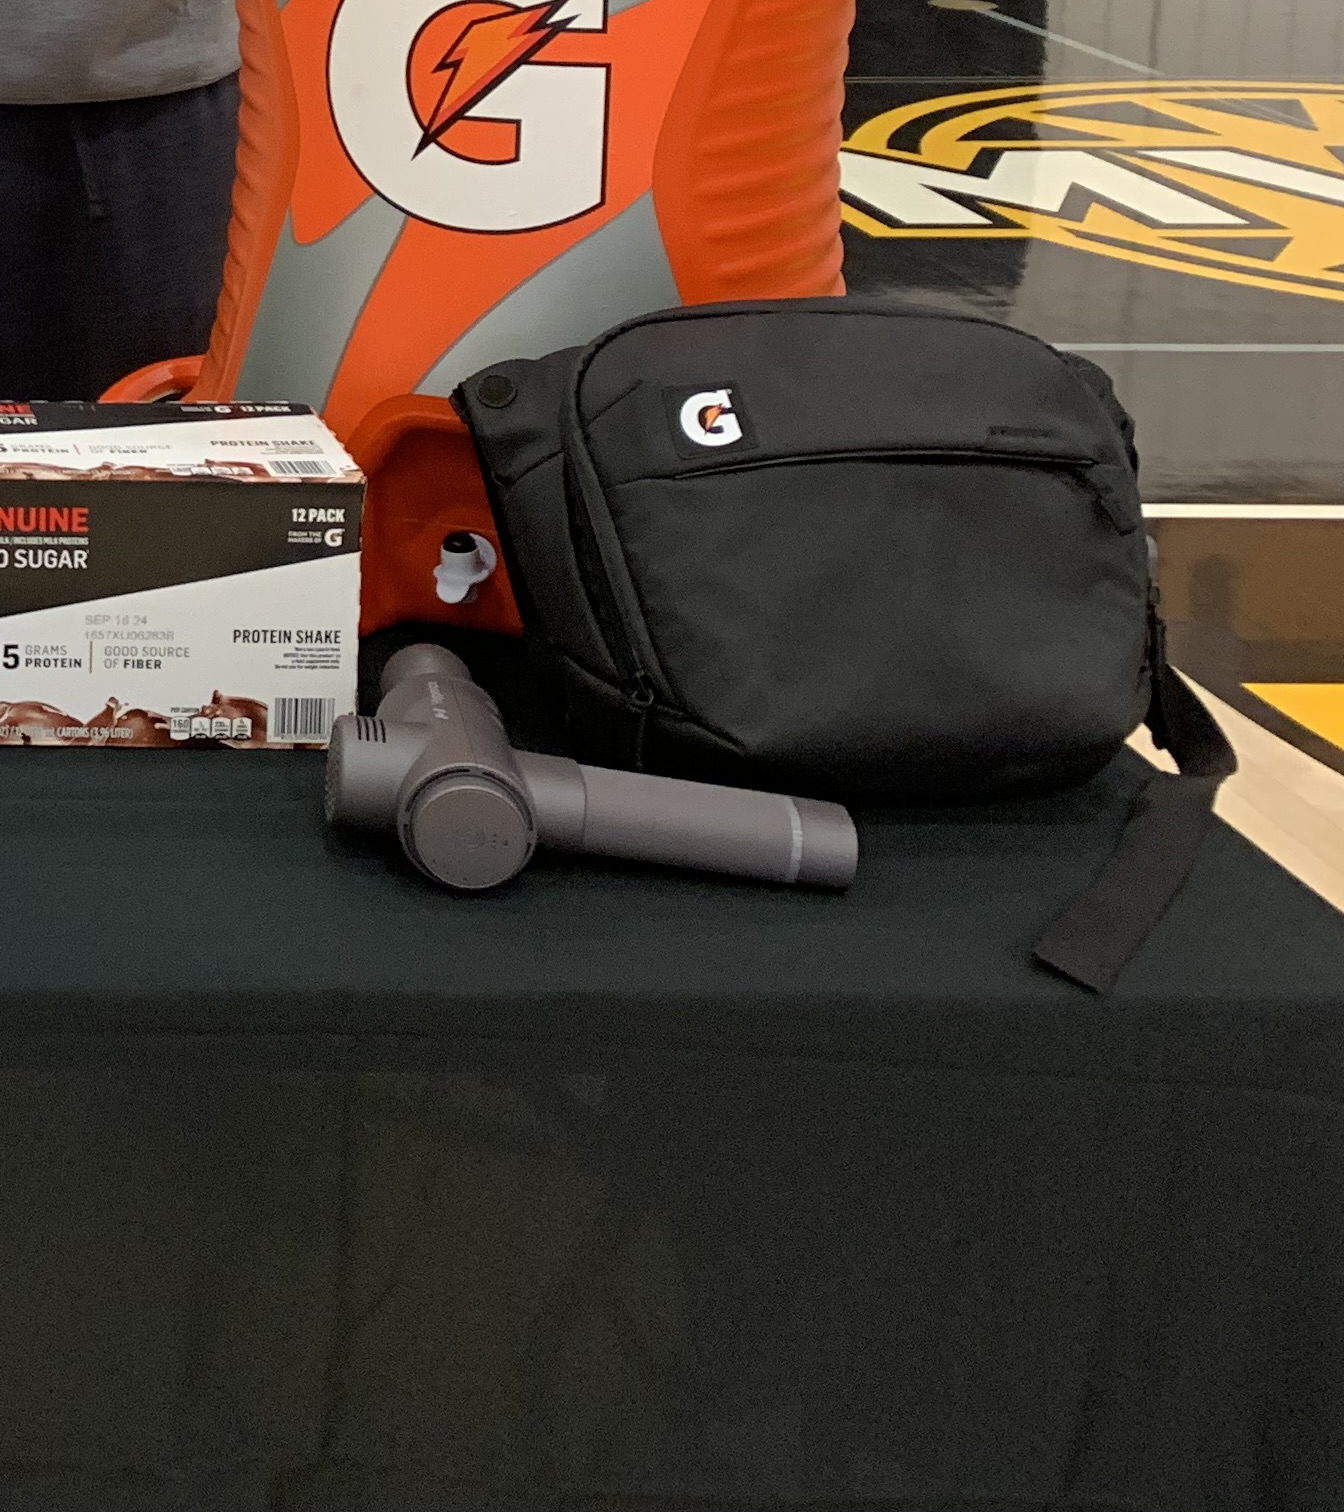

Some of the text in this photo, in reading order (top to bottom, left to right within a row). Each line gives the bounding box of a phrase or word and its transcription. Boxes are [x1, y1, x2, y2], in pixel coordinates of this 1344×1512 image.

[680, 389, 743, 447] G
[292, 509, 345, 523] 12 PACK
[14, 550, 87, 569] SUGAR
[85, 615, 111, 626] SEP
[132, 615, 147, 625] 24
[233, 629, 341, 644] PROTEIN SHAKE
[25, 645, 67, 656] GRAMS
[104, 646, 190, 657] GOOD SOURCE
[25, 658, 82, 669] PROTEIN
[104, 658, 161, 670] OF FIBER
